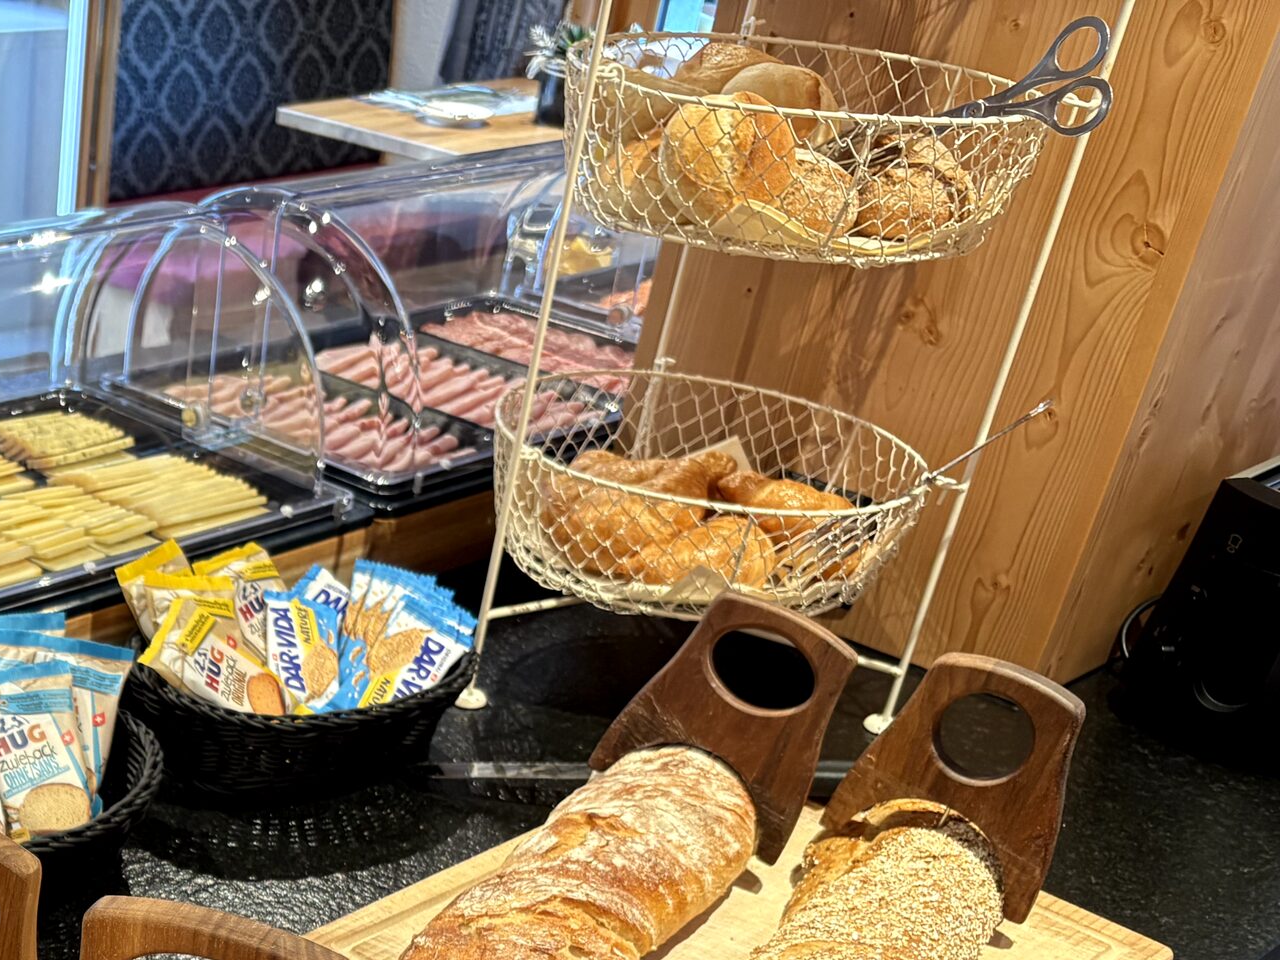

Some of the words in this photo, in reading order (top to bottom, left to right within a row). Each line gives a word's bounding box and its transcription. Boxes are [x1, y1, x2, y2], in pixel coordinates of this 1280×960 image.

[295, 605, 312, 645] NATURE
[205, 646, 225, 694] HUG
[221, 654, 238, 702] zwieback
[231, 671, 247, 707] ORIGINAL
